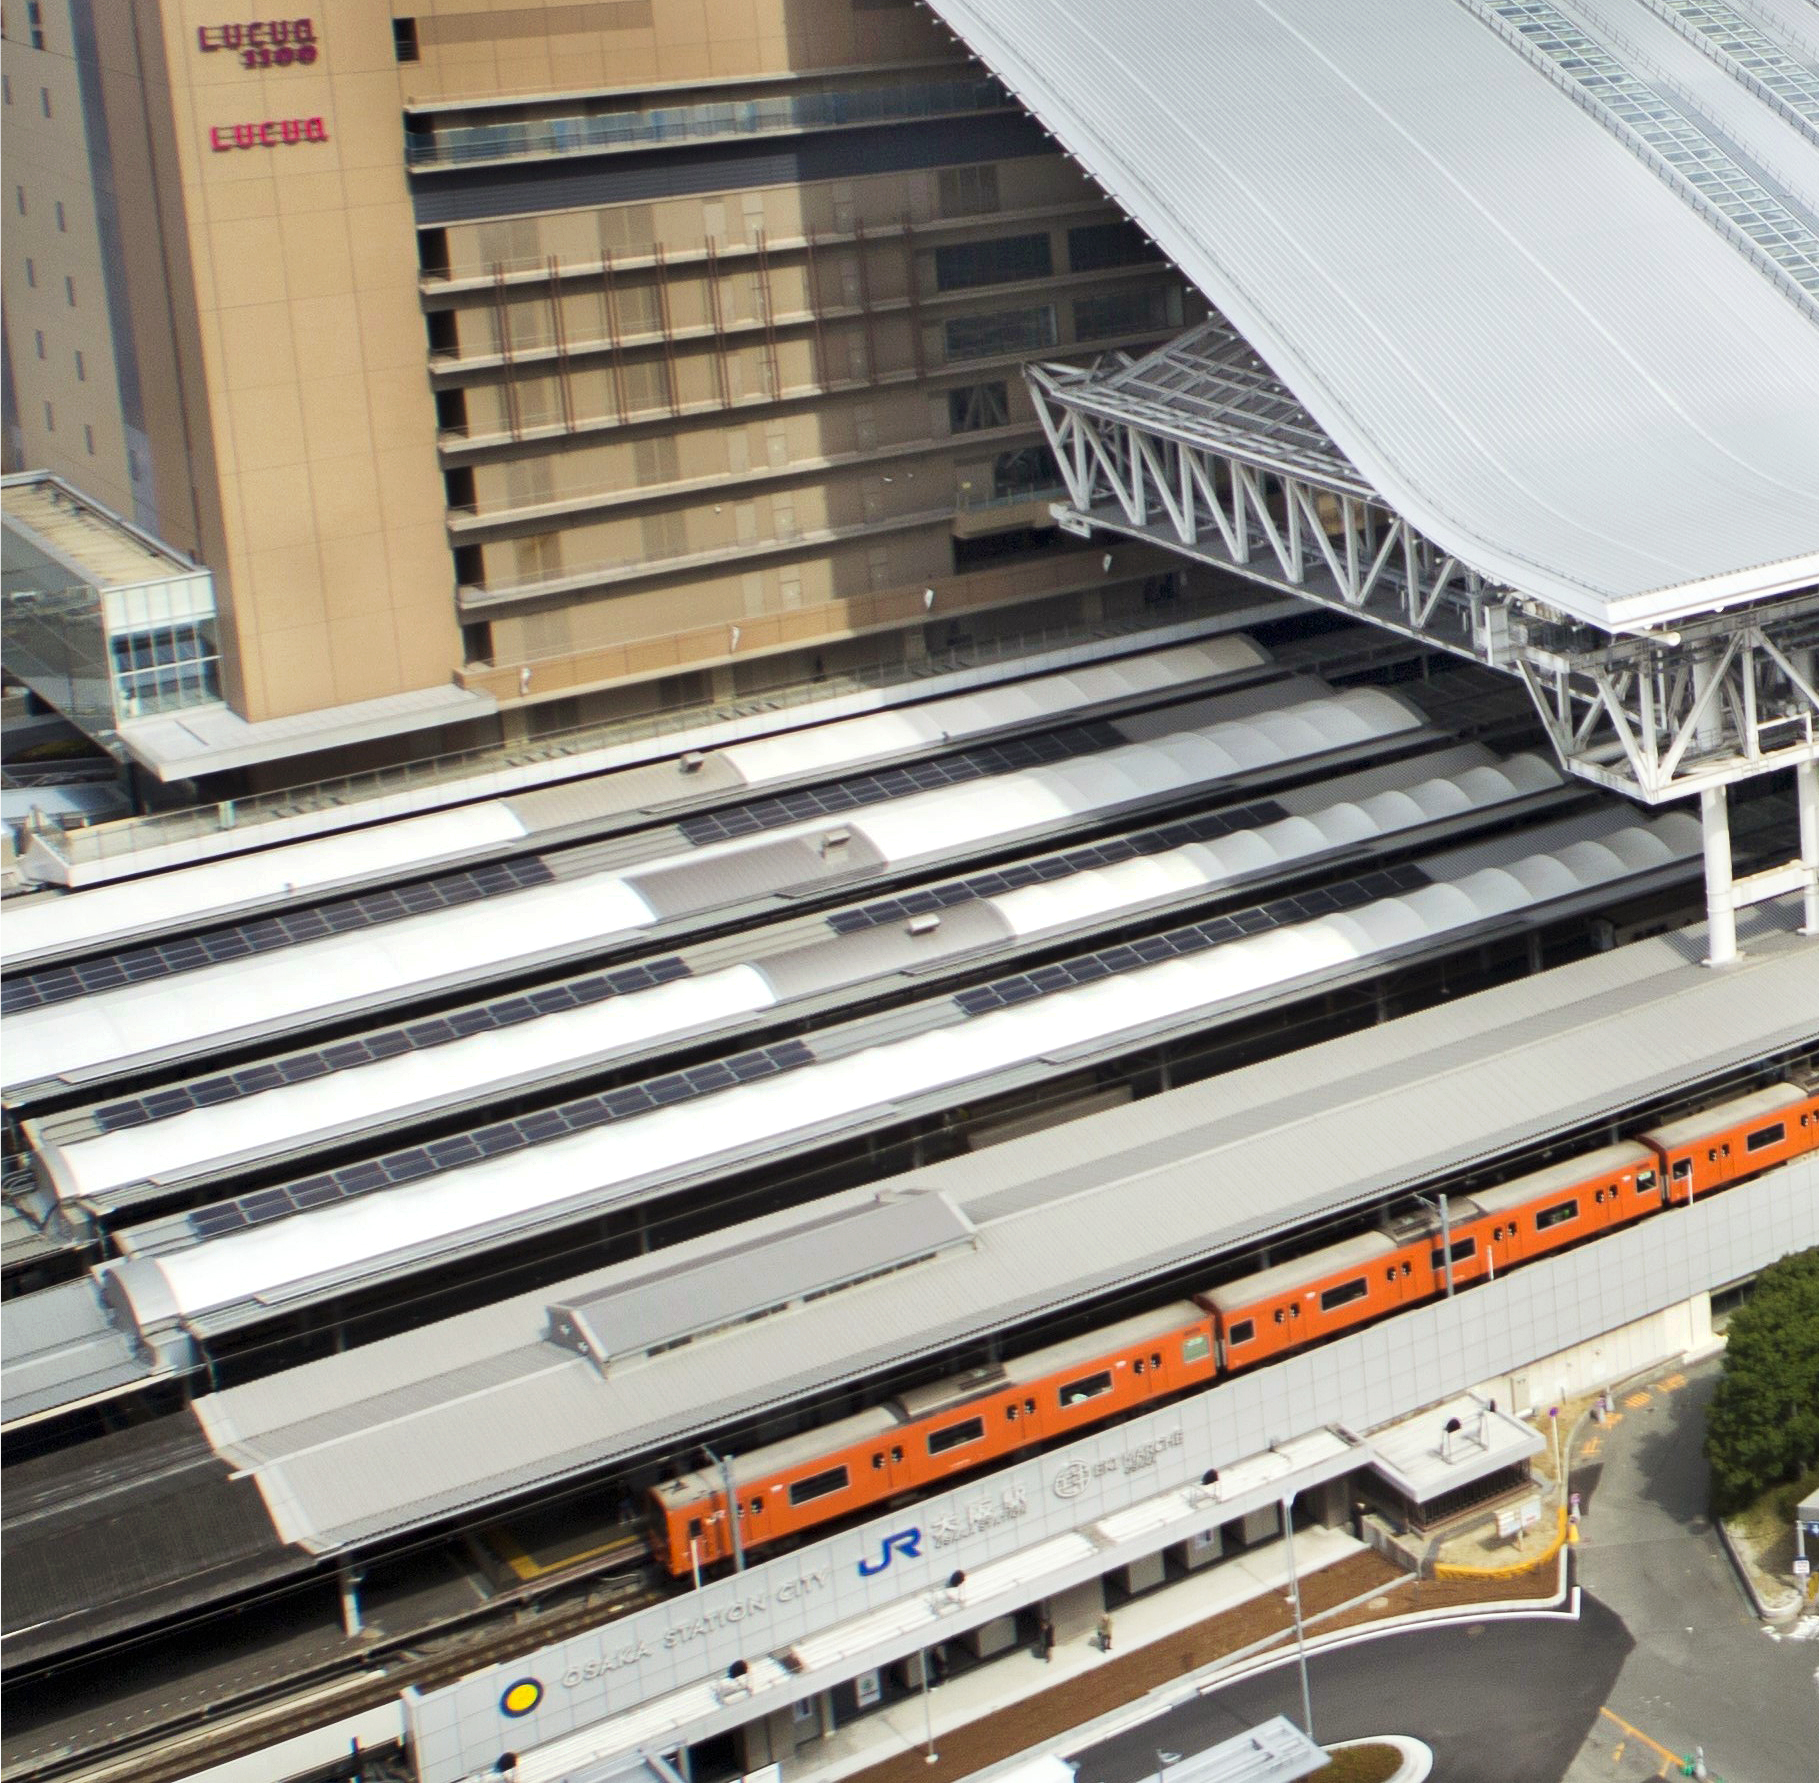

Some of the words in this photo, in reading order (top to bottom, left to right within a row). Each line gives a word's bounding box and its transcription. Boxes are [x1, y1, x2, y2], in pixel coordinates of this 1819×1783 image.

[859, 1527, 921, 1576] JR
[562, 1640, 652, 1687] OSAKA
[664, 1594, 767, 1648] STATION
[776, 1569, 833, 1603] CITY
